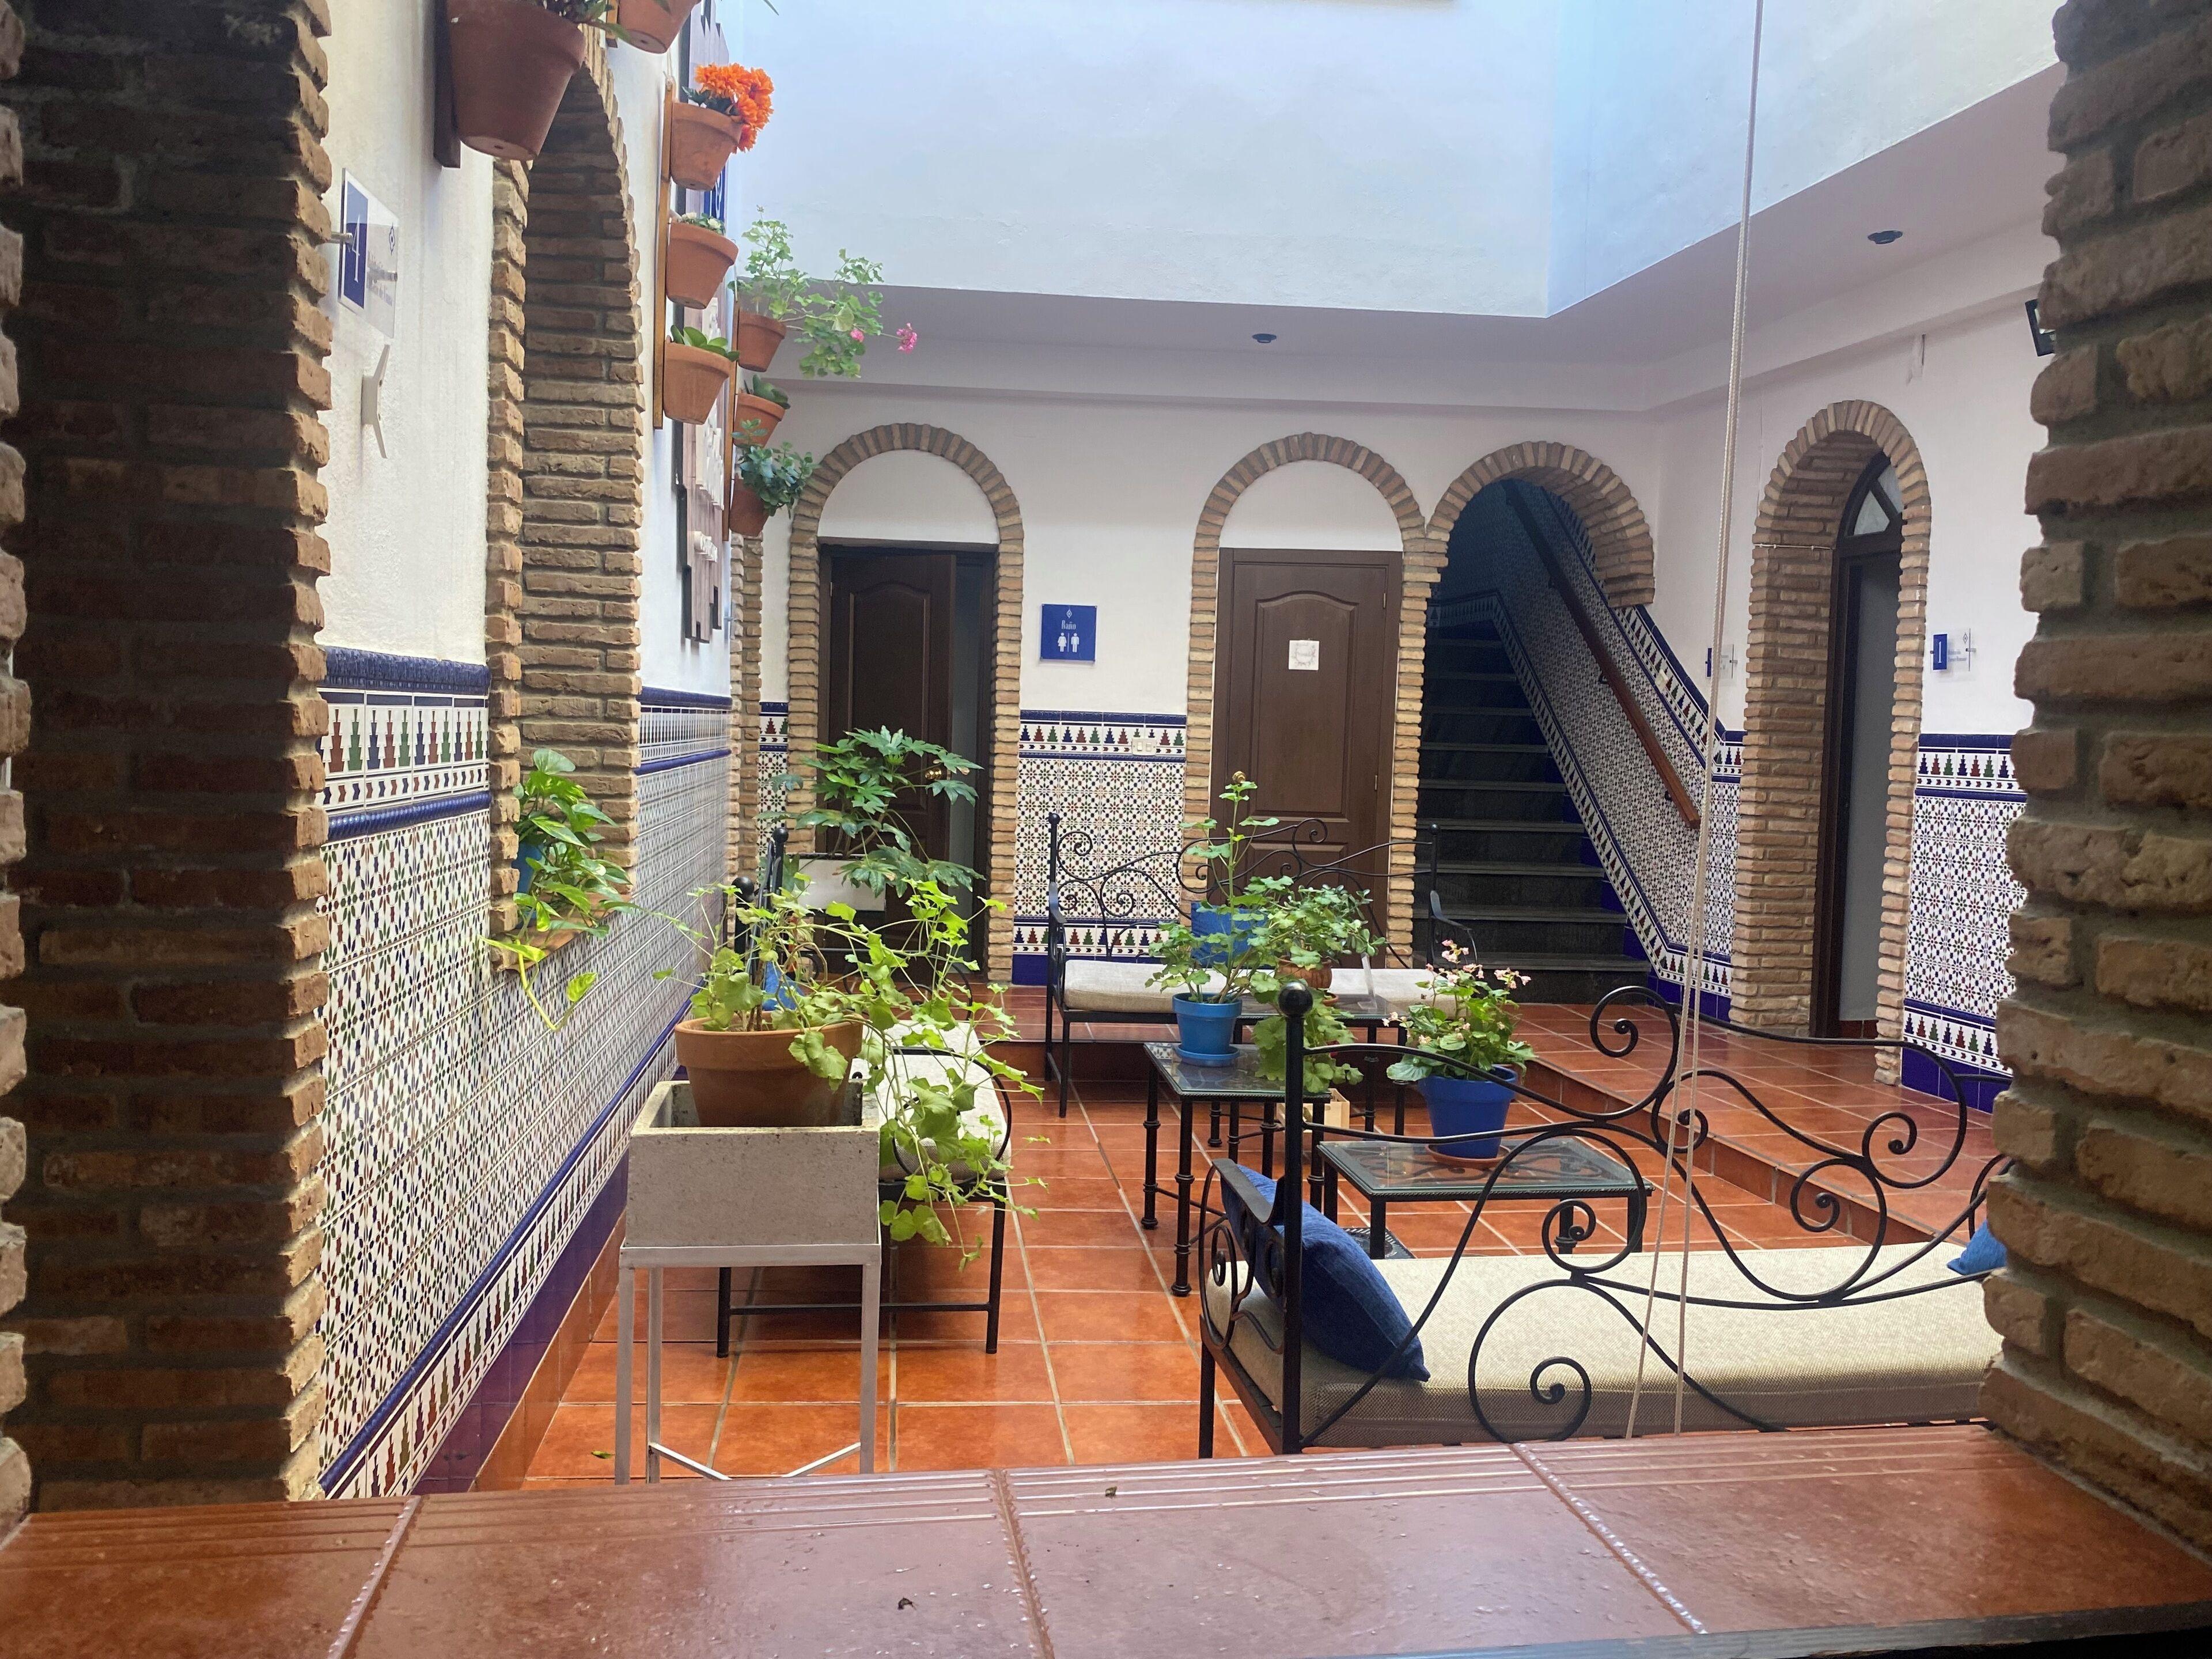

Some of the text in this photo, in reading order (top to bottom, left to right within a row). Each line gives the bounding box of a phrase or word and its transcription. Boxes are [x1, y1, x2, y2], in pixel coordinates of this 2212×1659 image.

[352, 214, 360, 283] 4
[1061, 620, 1076, 630] Baño
[1938, 641, 1942, 663] 1
